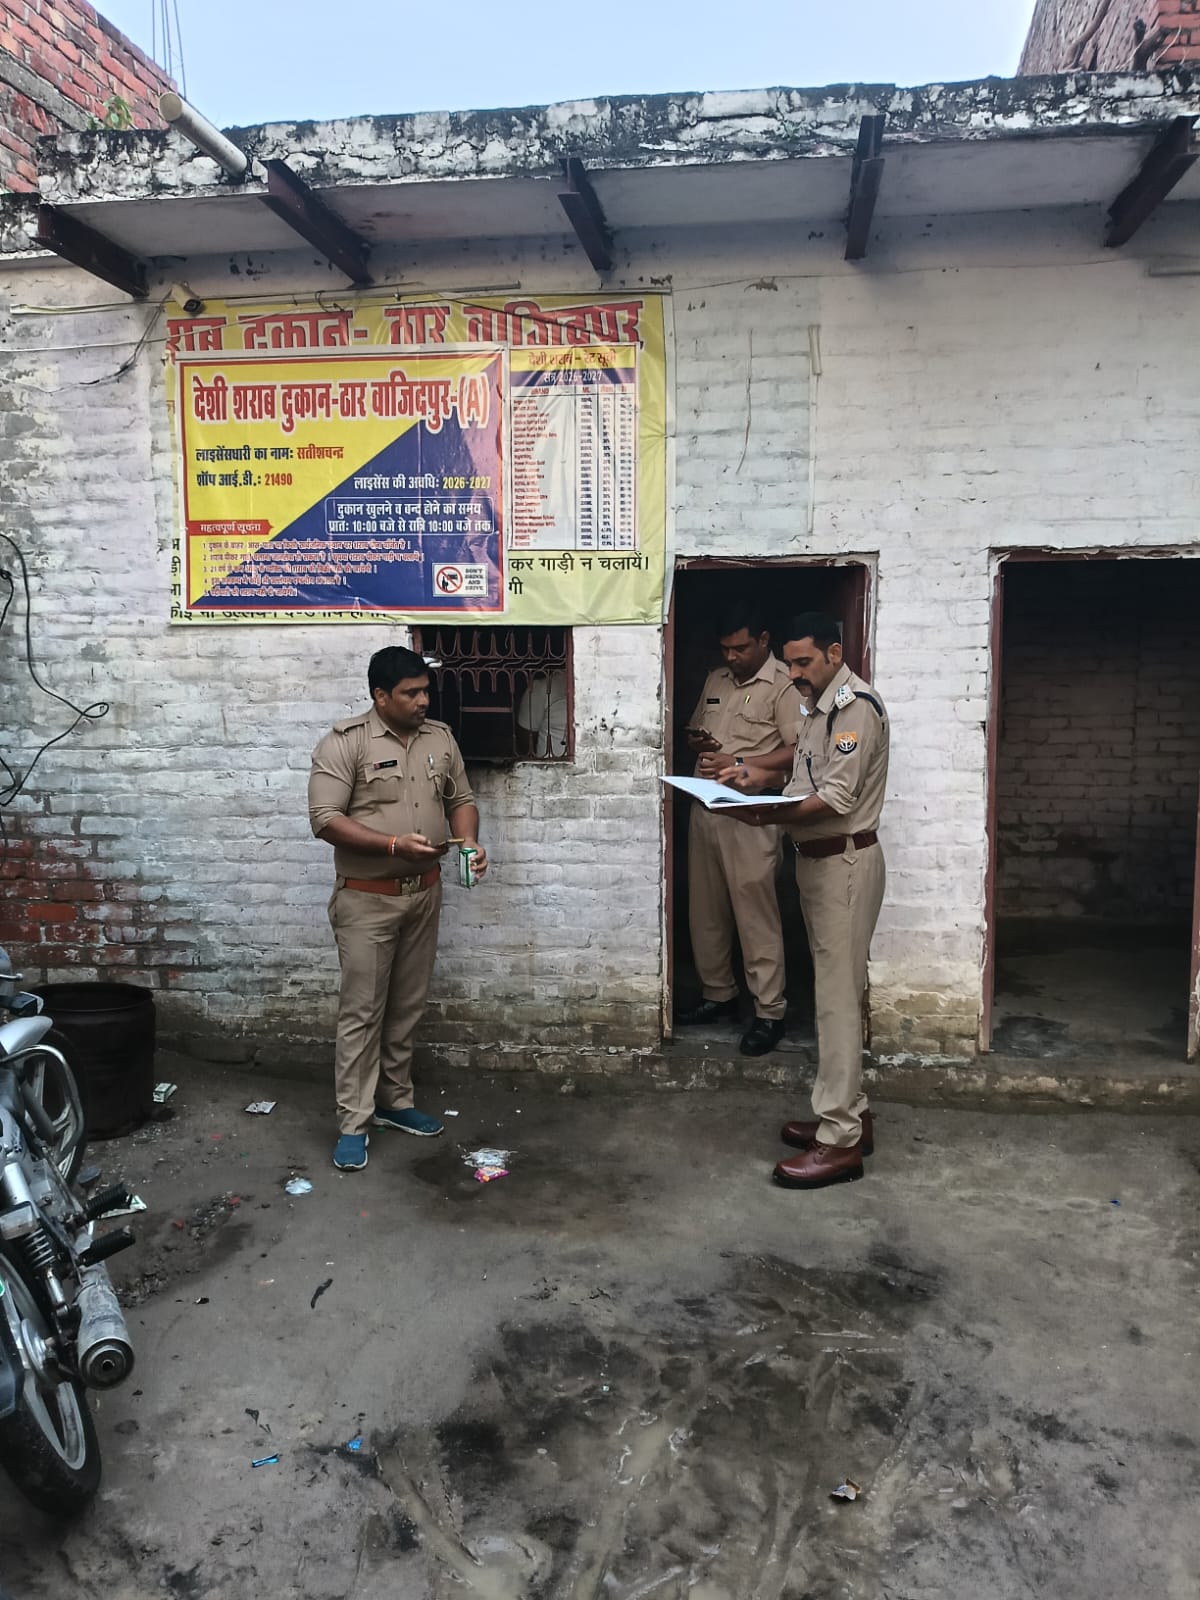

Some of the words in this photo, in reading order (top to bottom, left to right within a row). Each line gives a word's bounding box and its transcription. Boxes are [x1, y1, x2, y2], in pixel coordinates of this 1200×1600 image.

[192, 375, 228, 421] देशी
[233, 384, 277, 420] शराब
[196, 444, 251, 463] लाइसेंसधारी
[254, 446, 268, 460] का
[296, 443, 344, 460] सतीशचन्द्र
[196, 470, 217, 486] शॉप
[265, 473, 292, 486] 21490
[354, 474, 390, 491] लाइसेंस
[392, 473, 406, 489] की
[442, 476, 491, 489] 2026-2027
[337, 503, 363, 519] दुकान
[366, 500, 392, 519] खुलने
[395, 503, 402, 515] व
[404, 503, 421, 515] बन्द
[424, 500, 440, 515] होने
[443, 503, 456, 515] का
[458, 503, 482, 514] समय
[238, 523, 261, 534] सूचना
[352, 520, 377, 532] 10:00
[380, 517, 395, 532] बजे
[398, 517, 405, 532] से
[408, 516, 426, 532] रात्रि
[428, 520, 453, 532] 10:00
[456, 517, 472, 532] बजे
[475, 519, 492, 531] तक
[508, 557, 534, 571] कर
[538, 552, 574, 574] गाड़ी
[580, 557, 592, 571] न
[508, 576, 523, 595] गी
